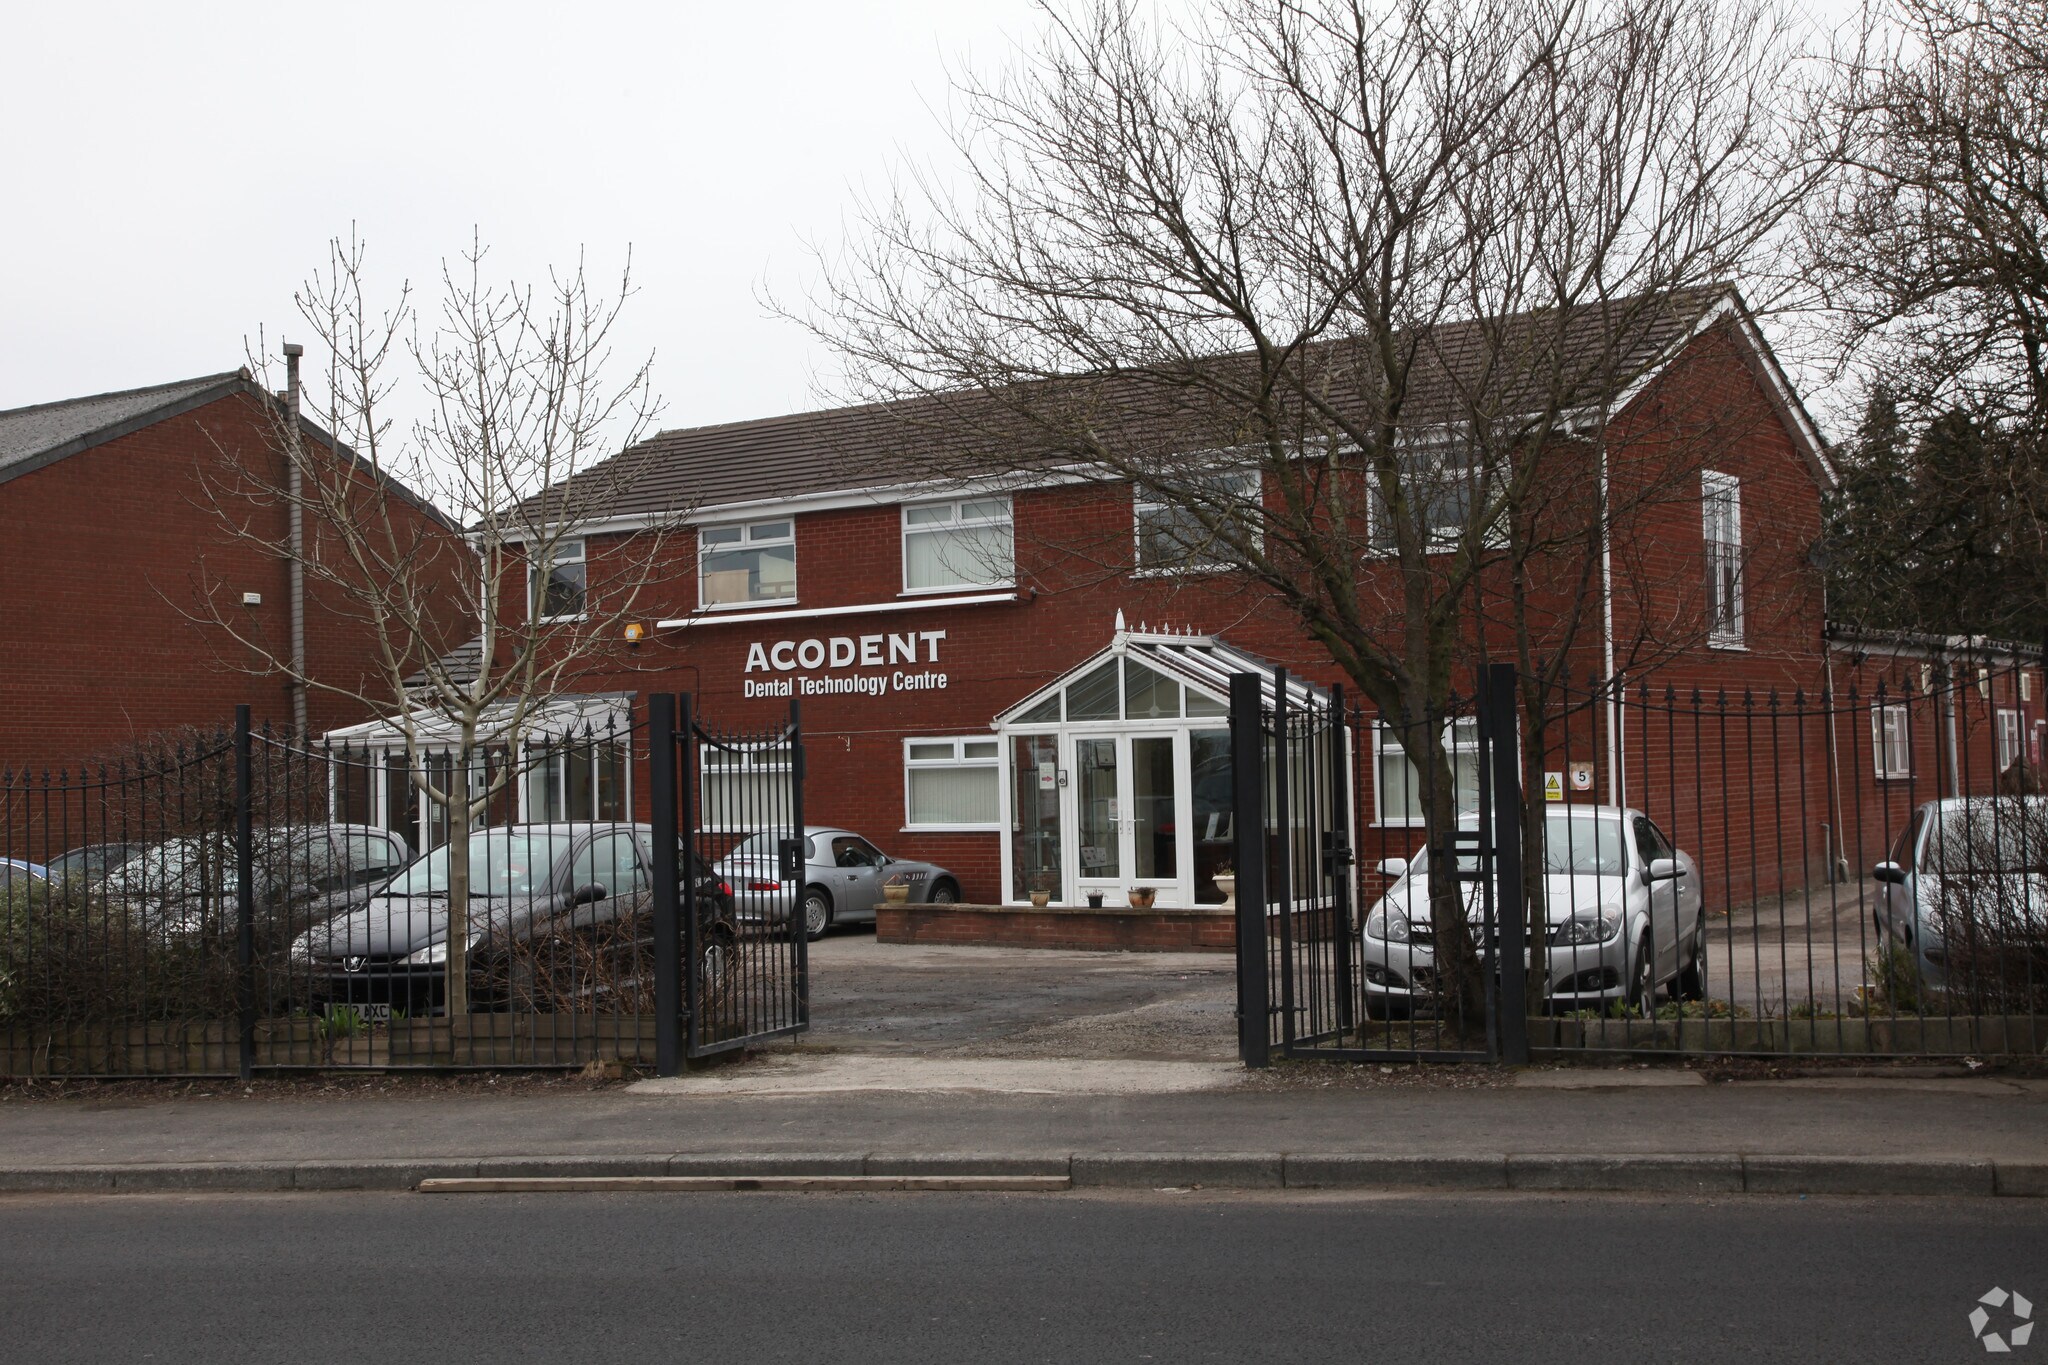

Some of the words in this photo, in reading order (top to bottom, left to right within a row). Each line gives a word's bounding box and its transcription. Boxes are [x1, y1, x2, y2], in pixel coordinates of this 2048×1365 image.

[744, 629, 946, 673] ACODENT
[744, 677, 793, 698] Dental
[797, 674, 888, 696] Technology
[892, 670, 947, 692] Centre
[1578, 771, 1586, 782] 5
